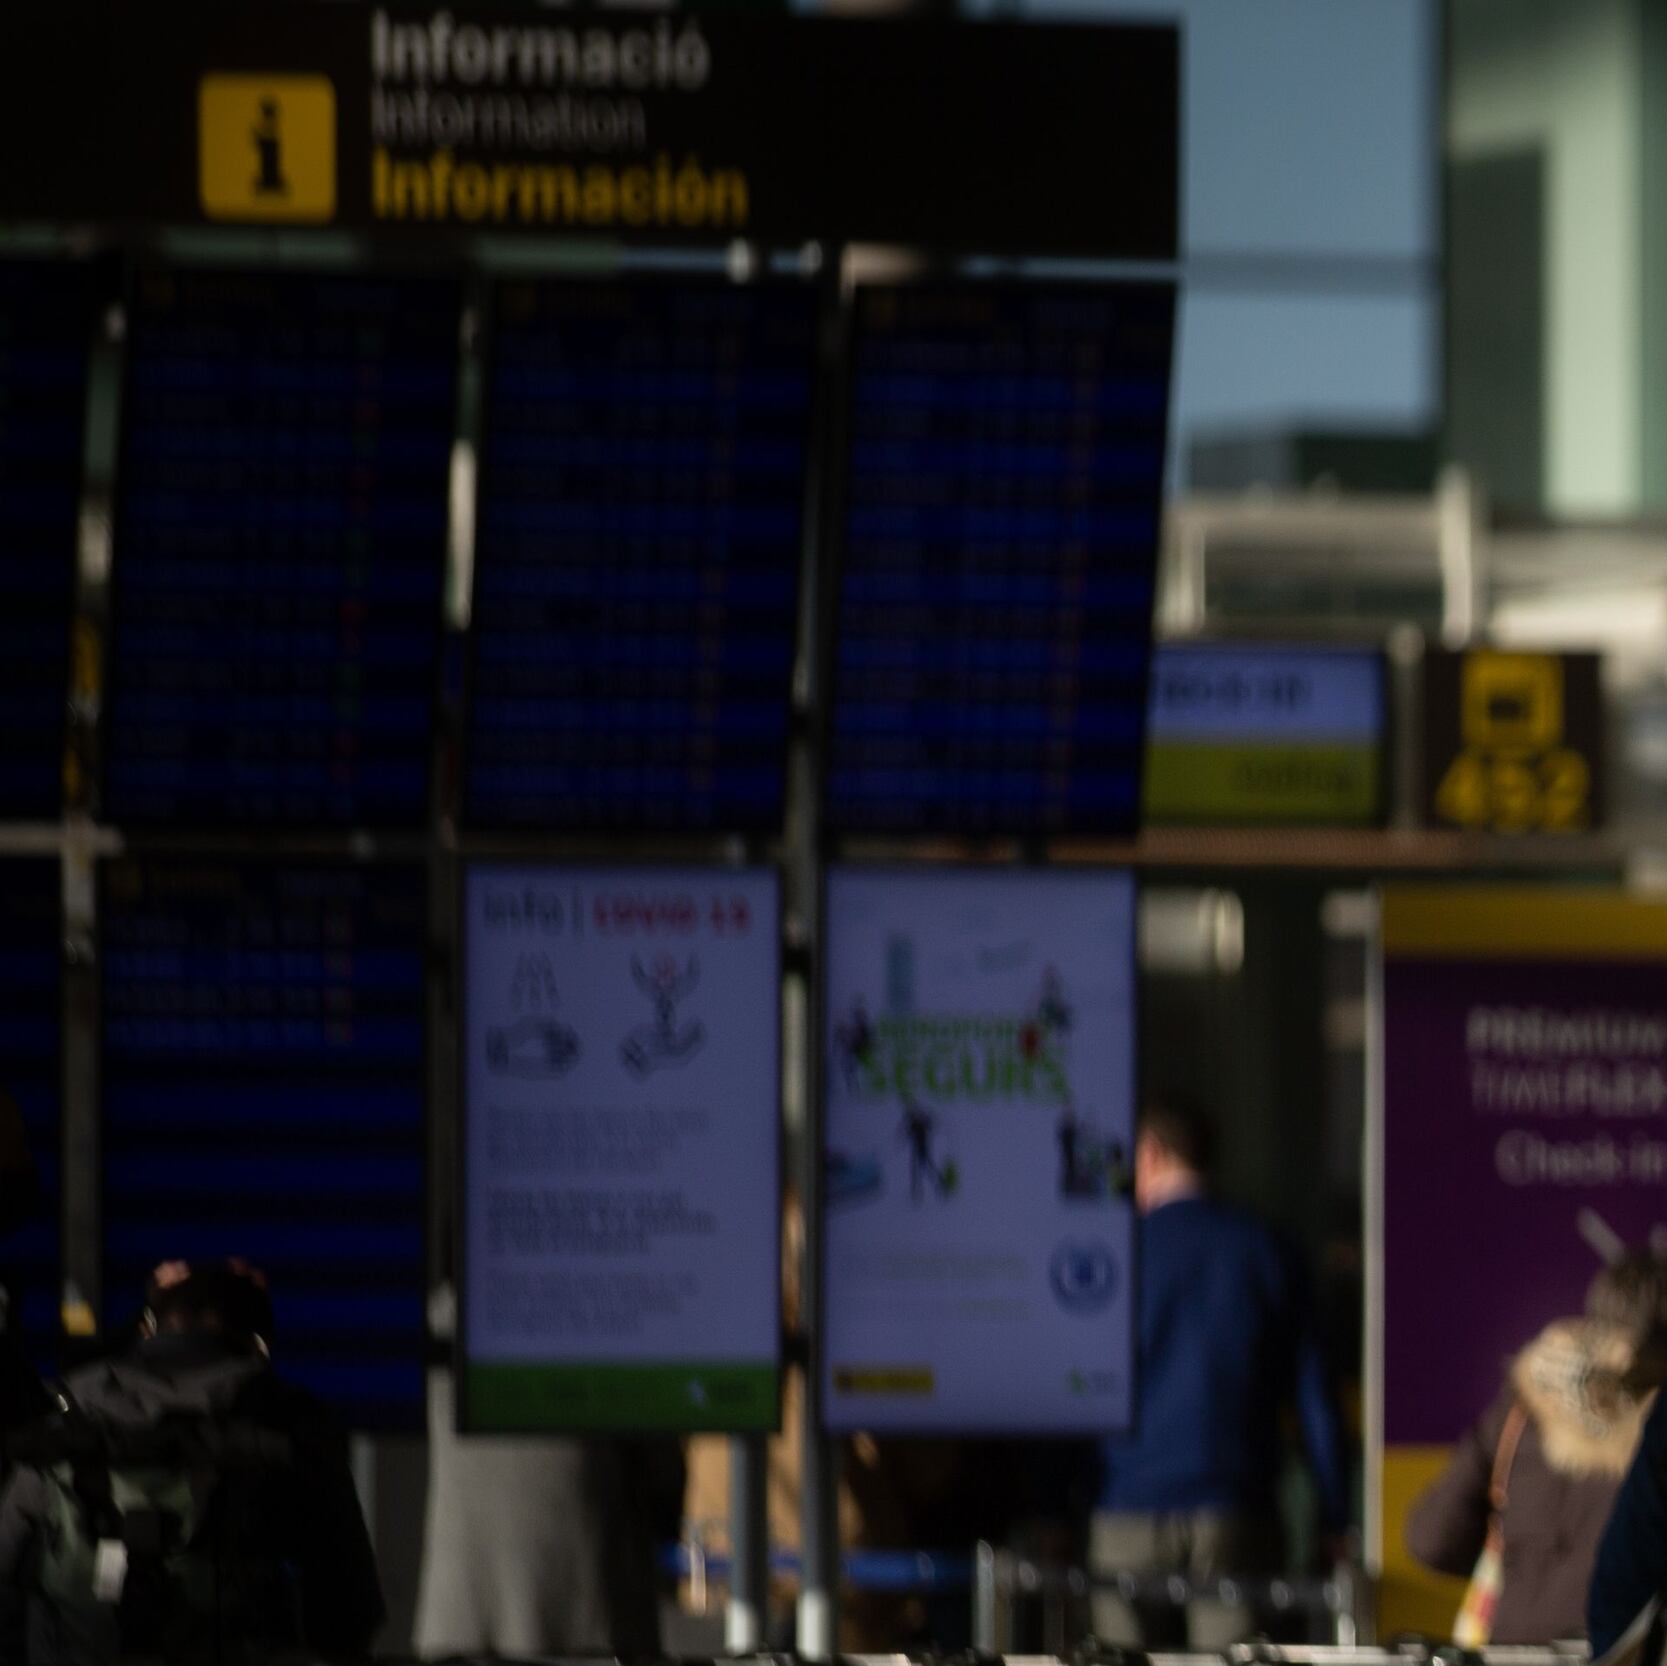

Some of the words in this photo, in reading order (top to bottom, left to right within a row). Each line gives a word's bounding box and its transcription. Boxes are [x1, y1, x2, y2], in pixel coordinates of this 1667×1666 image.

[370, 9, 711, 92] Informació
[370, 82, 647, 151] Information
[370, 145, 751, 227] Información
